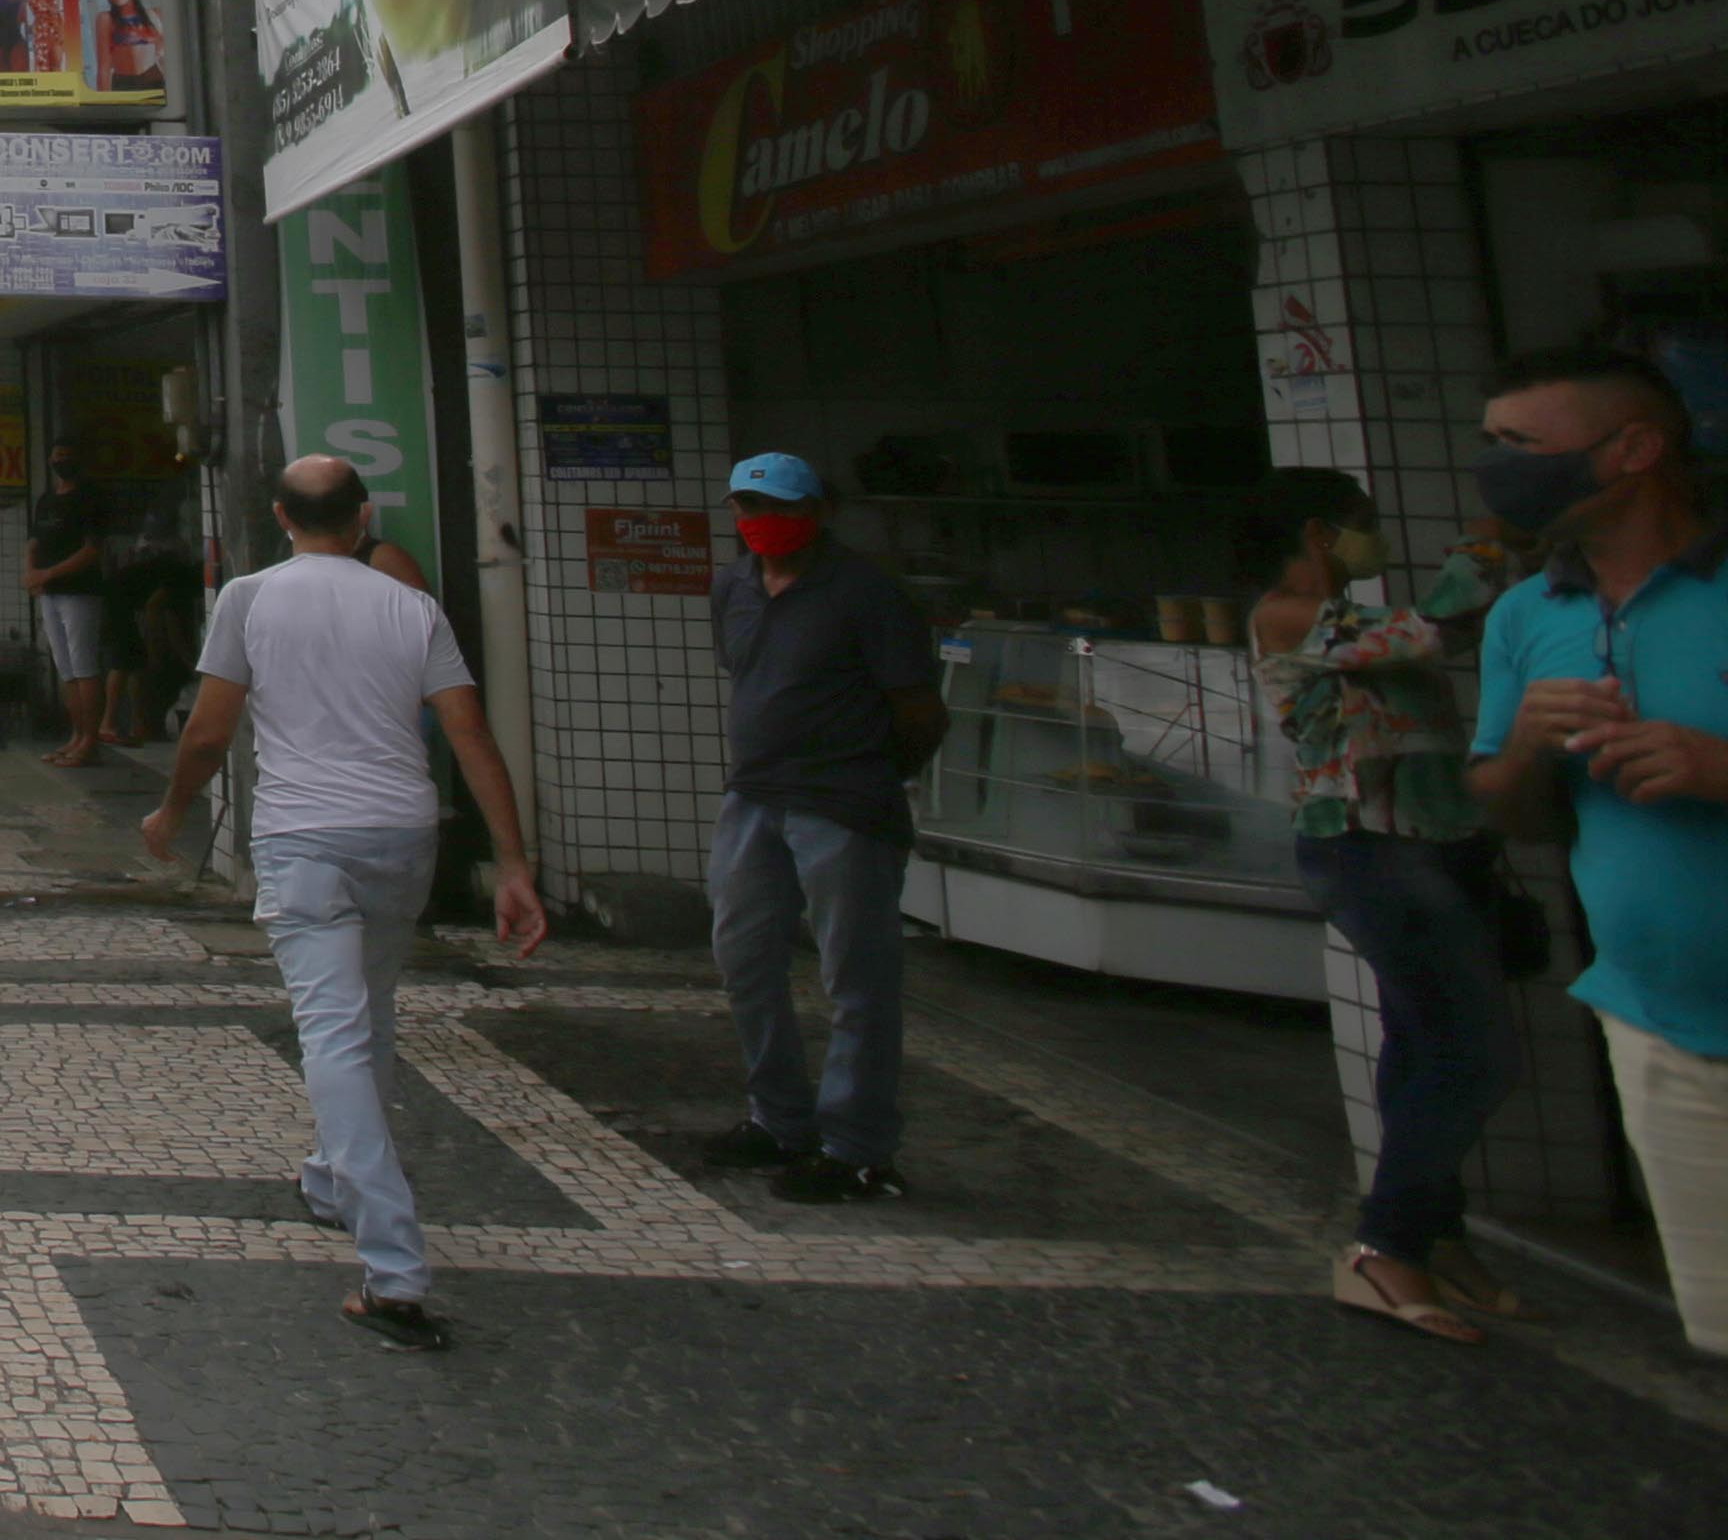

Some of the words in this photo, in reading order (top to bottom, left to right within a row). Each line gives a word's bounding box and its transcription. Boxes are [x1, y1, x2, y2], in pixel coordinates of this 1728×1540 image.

[790, 0, 919, 71] Shopping
[1452, 36, 1472, 62] A
[1474, 12, 1578, 56] CUECA
[697, 42, 929, 255] Camelo
[661, 546, 708, 559] ONLINE
